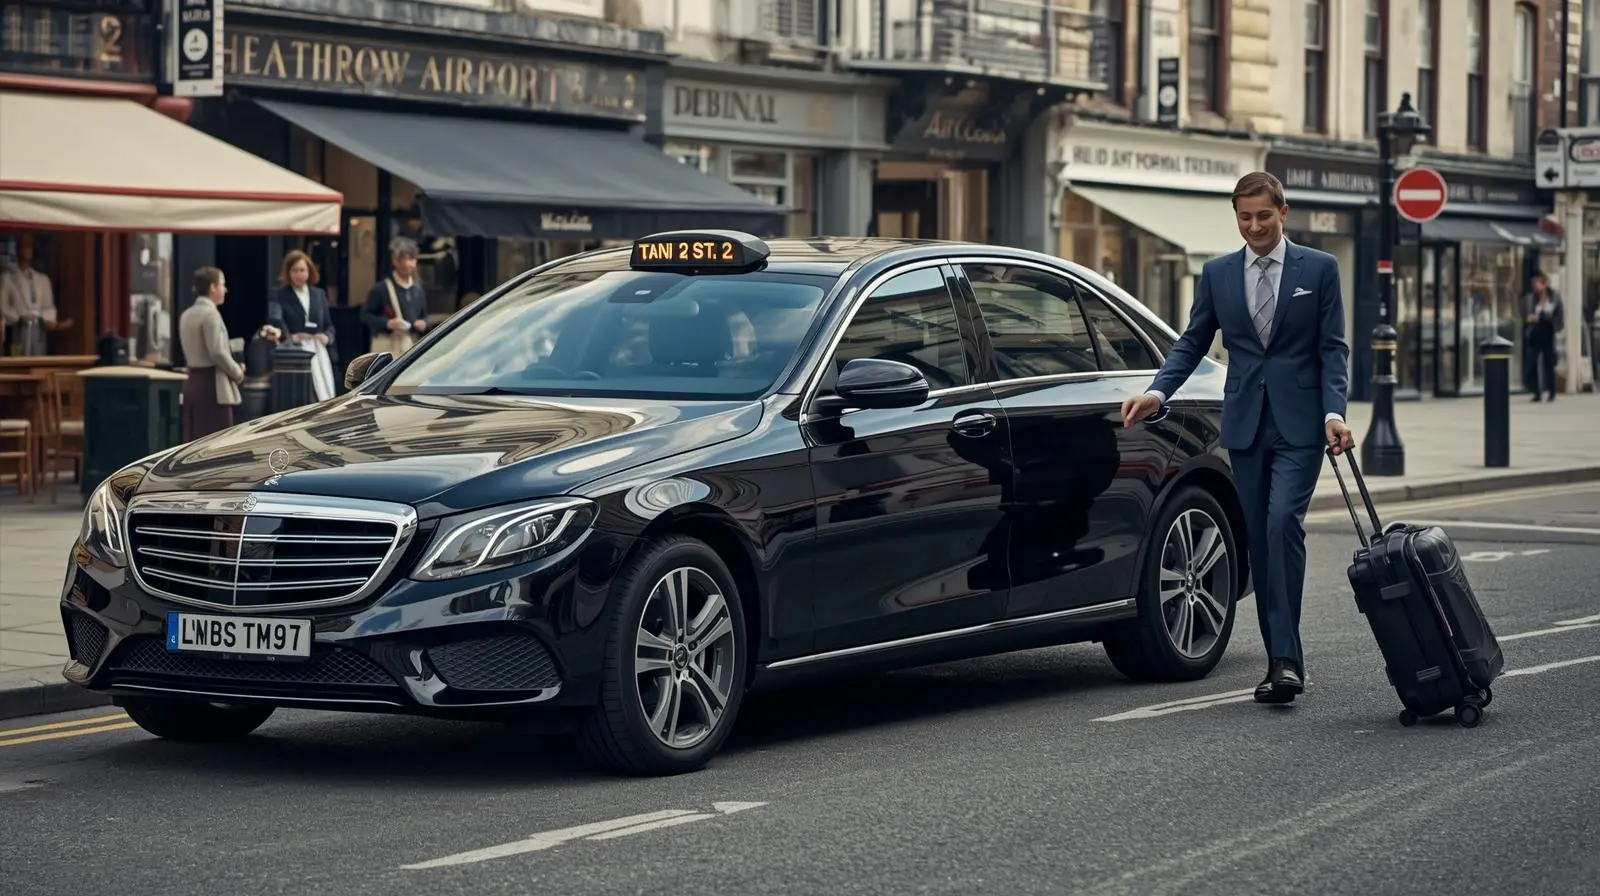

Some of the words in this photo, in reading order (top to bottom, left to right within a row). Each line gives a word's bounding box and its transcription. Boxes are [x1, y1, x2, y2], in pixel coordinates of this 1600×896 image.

[223, 33, 411, 85] HEATHROW
[419, 56, 560, 105] AIRPORT
[639, 243, 673, 260] TANI
[679, 242, 689, 260] 2
[692, 242, 717, 260] ST.
[722, 242, 733, 260] 2
[243, 622, 301, 651] TM97
